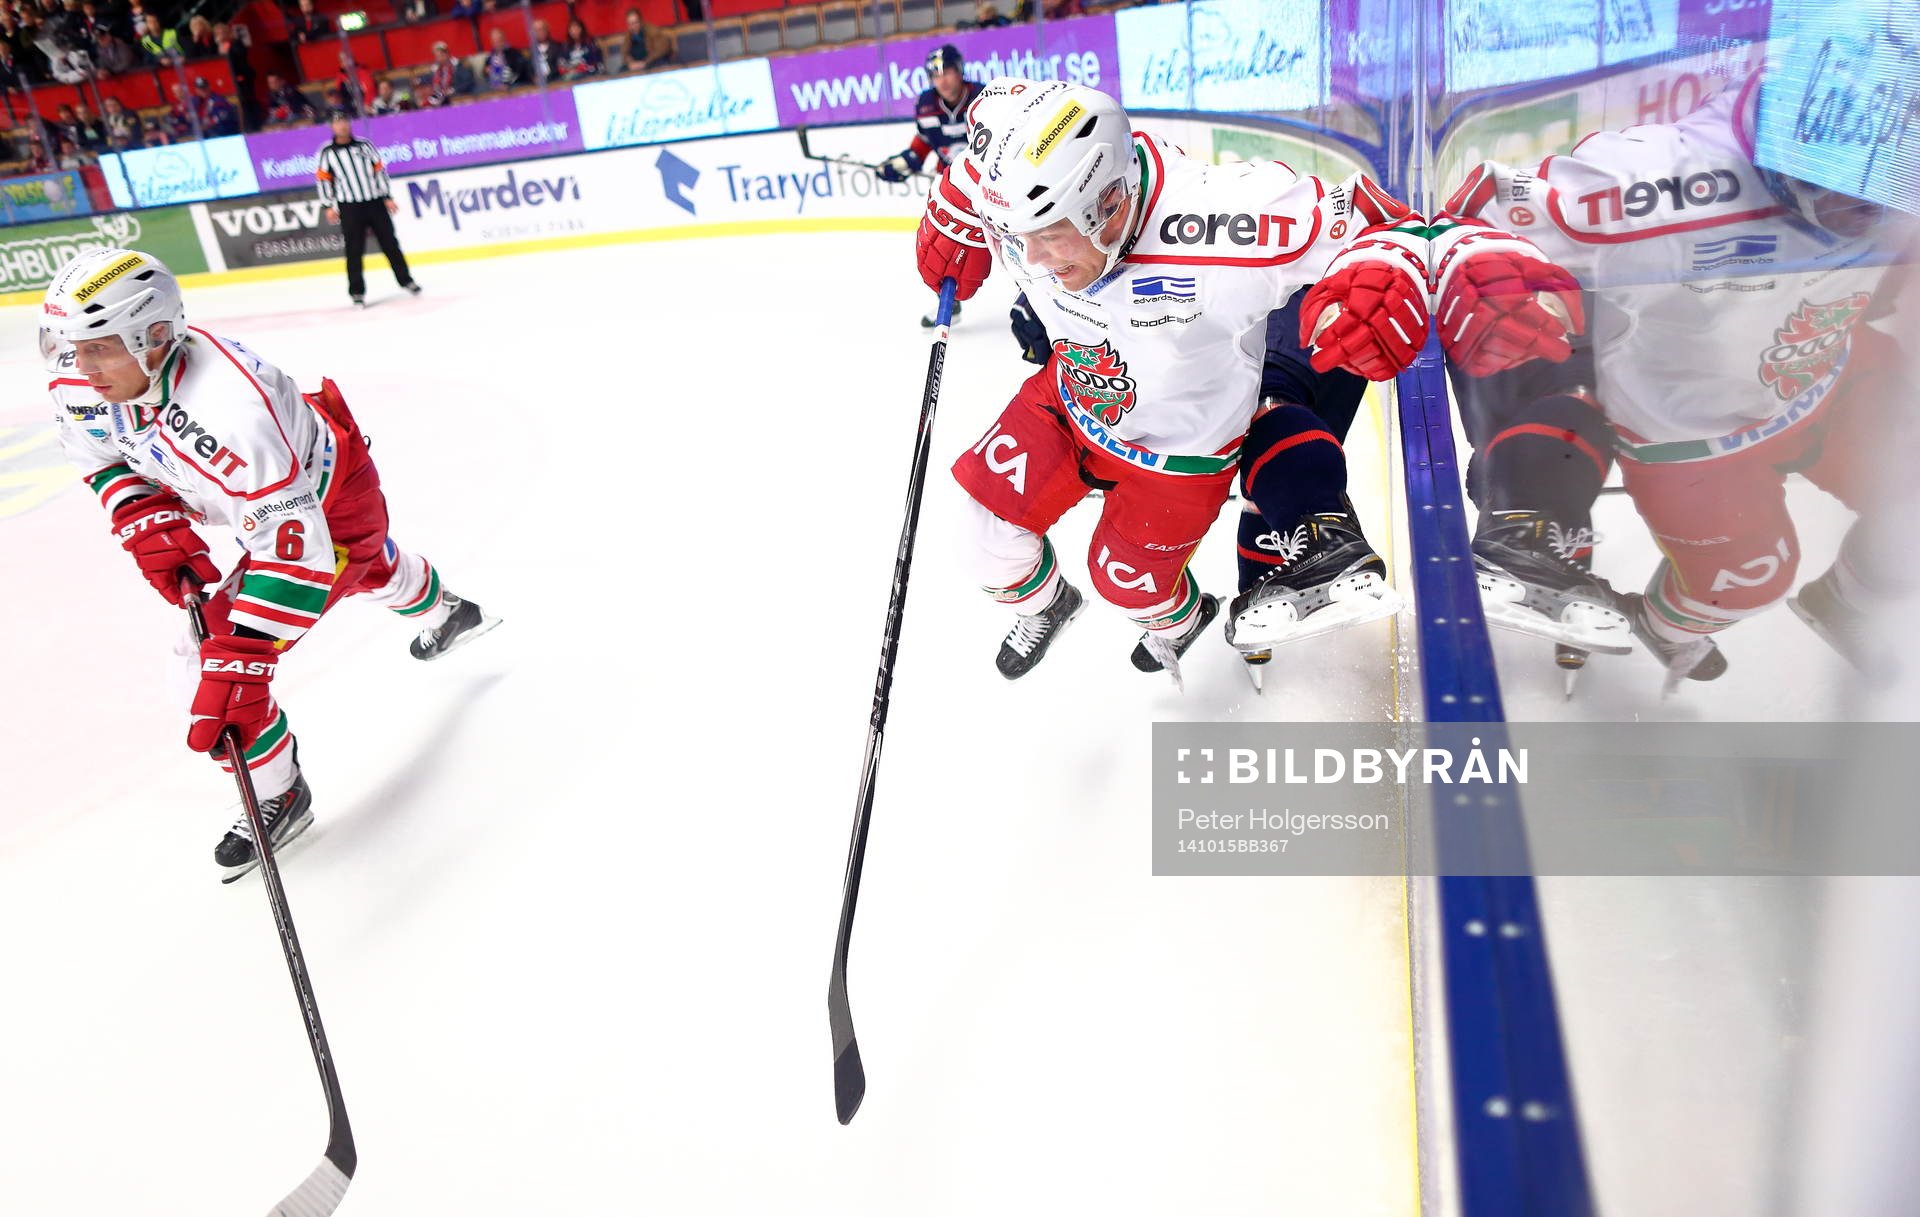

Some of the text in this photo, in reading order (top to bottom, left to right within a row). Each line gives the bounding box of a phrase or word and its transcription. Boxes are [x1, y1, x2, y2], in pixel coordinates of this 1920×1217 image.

[1159, 213, 1298, 247] coreIT
[75, 255, 143, 302] Mekonomen
[931, 343, 947, 400] EASTON
[165, 402, 249, 477] coreIT
[974, 423, 1029, 496] ICA
[275, 518, 305, 561] 6
[1096, 545, 1158, 594] ICA
[201, 658, 278, 677] EAST
